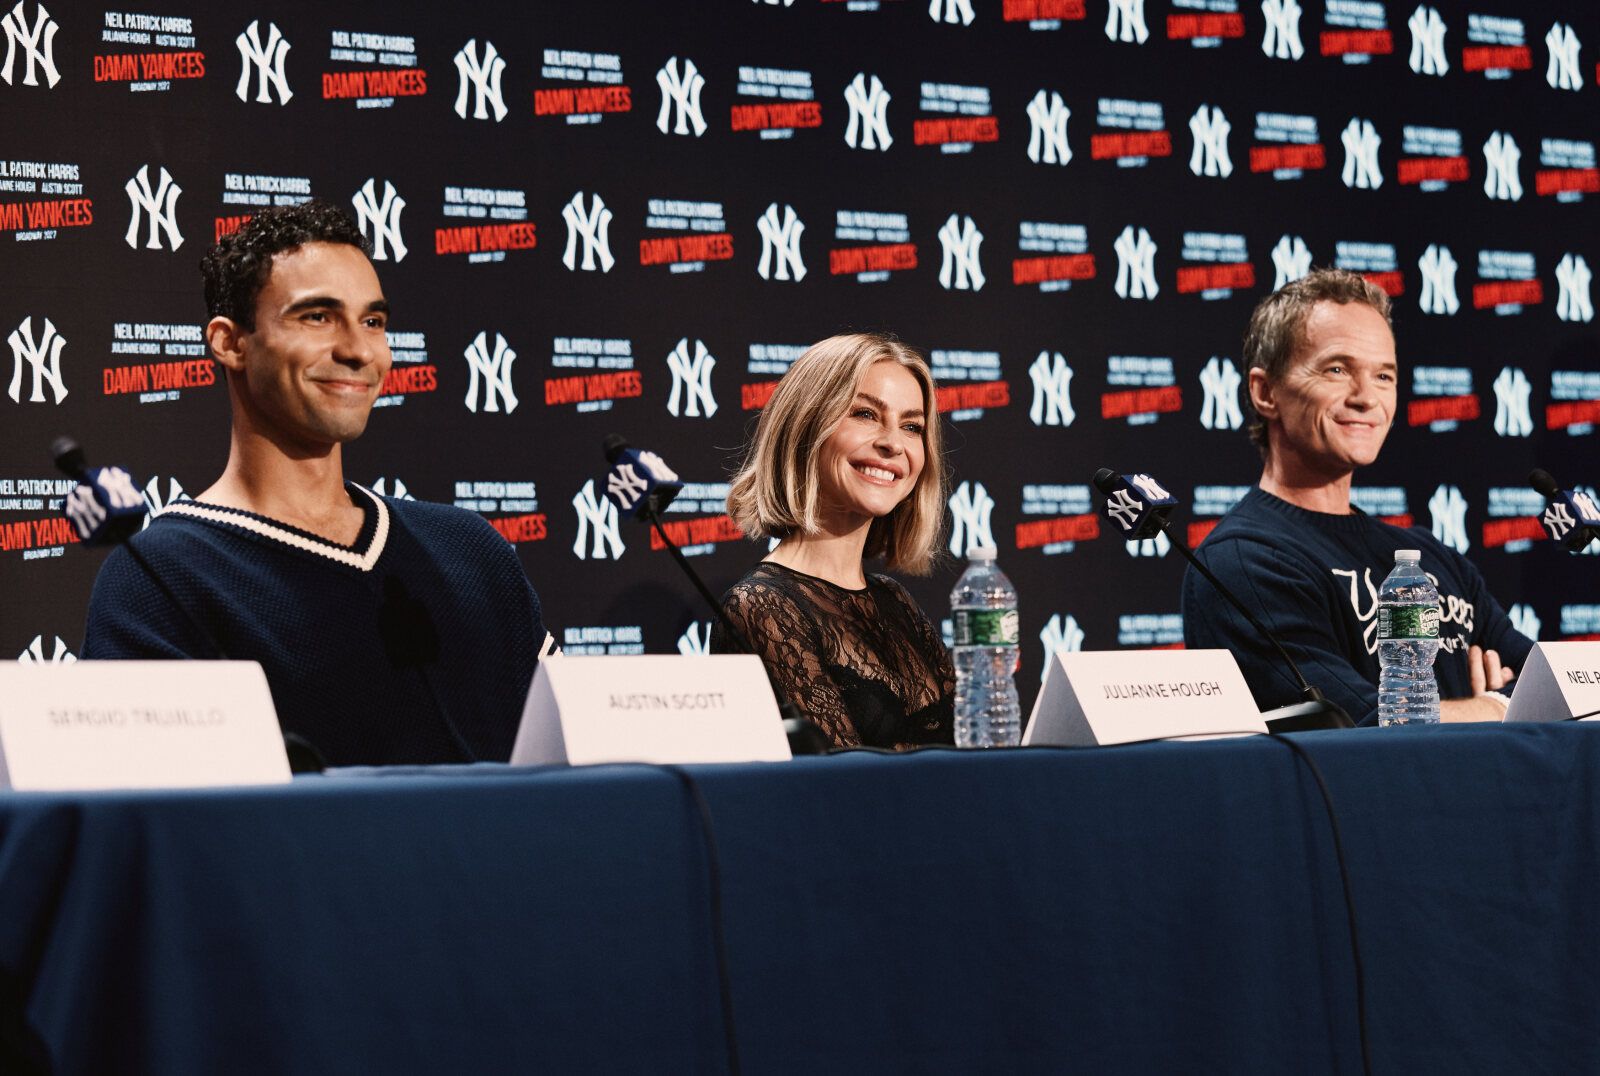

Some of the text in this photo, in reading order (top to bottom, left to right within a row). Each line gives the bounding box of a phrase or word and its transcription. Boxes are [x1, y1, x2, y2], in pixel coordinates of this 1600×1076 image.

[105, 11, 193, 34] NEIL PATRICK HARRIS
[94, 51, 206, 82] DAMN YANKEES
[322, 69, 428, 99] DAMN YANKEES
[10, 161, 46, 179] PATRICK
[47, 163, 79, 180] HARRIS
[25, 199, 93, 230] YANKEES
[114, 323, 134, 339] NEIL
[134, 323, 171, 341] PATRICK
[104, 359, 215, 395] DAMN YANKEES
[17, 480, 55, 497] PATRICK
[1566, 670, 1595, 684] NEIL
[1104, 681, 1223, 699] JULIANNE HOUGH
[610, 693, 725, 710] AUSTIN SCOTT
